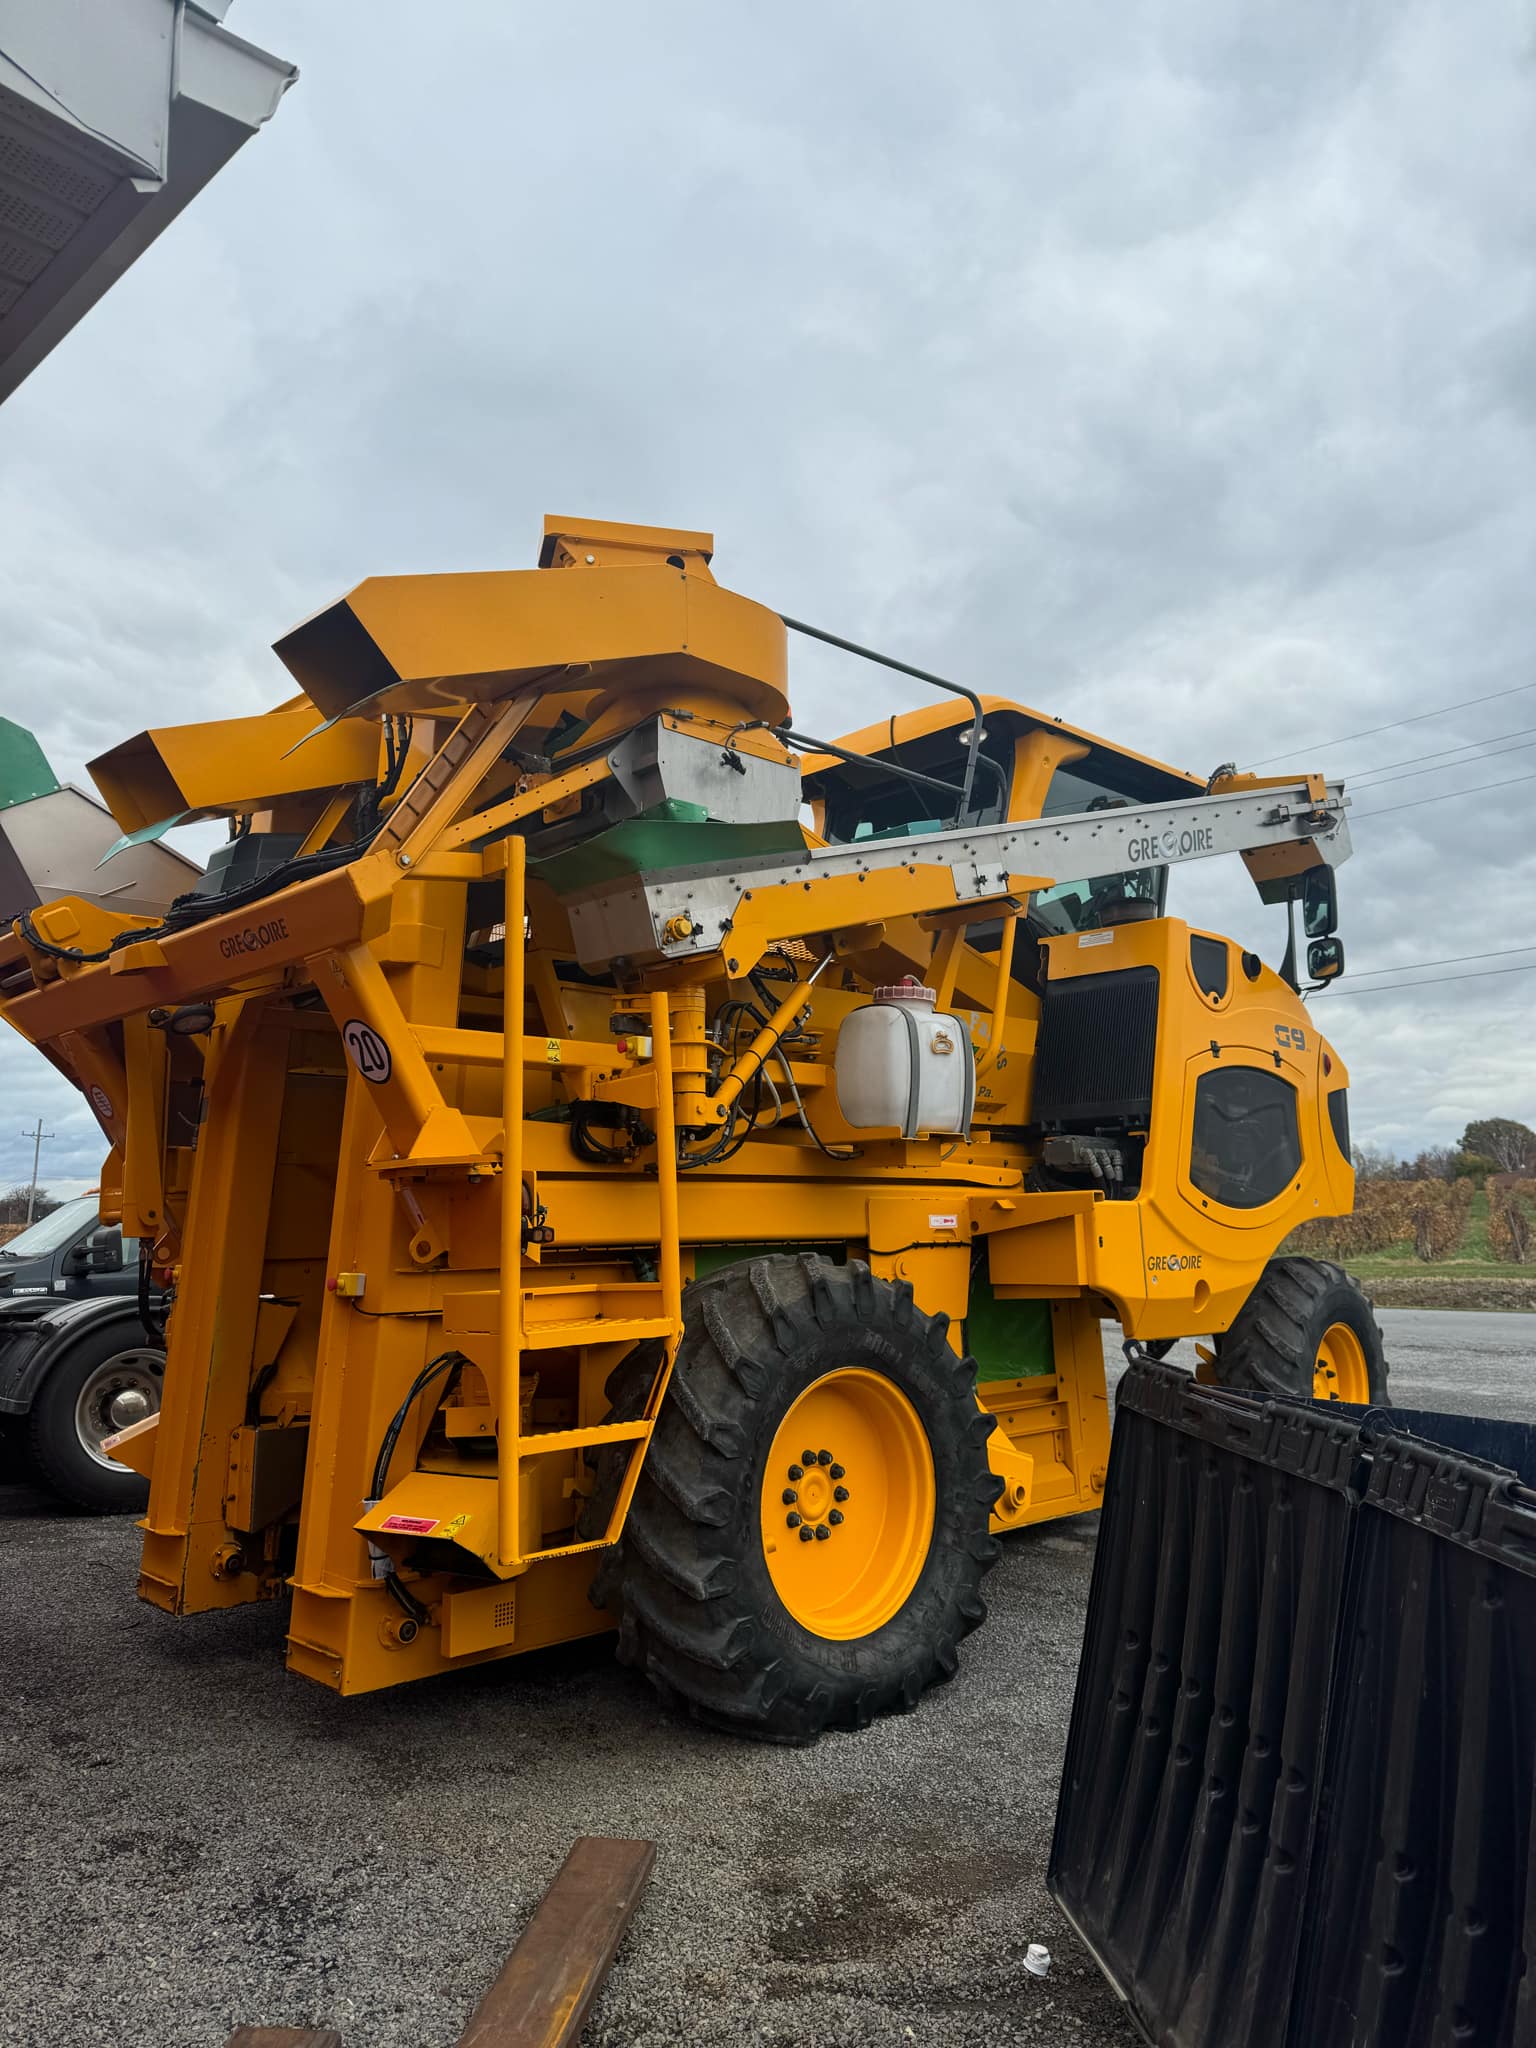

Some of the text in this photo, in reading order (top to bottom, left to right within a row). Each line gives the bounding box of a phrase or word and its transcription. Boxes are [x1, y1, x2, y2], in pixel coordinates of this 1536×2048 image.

[1128, 827, 1213, 863] GREGOIRE
[220, 918, 289, 958] GREGOIRE
[349, 1030, 386, 1073] 20
[1147, 1254, 1203, 1272] GREGOIRE
